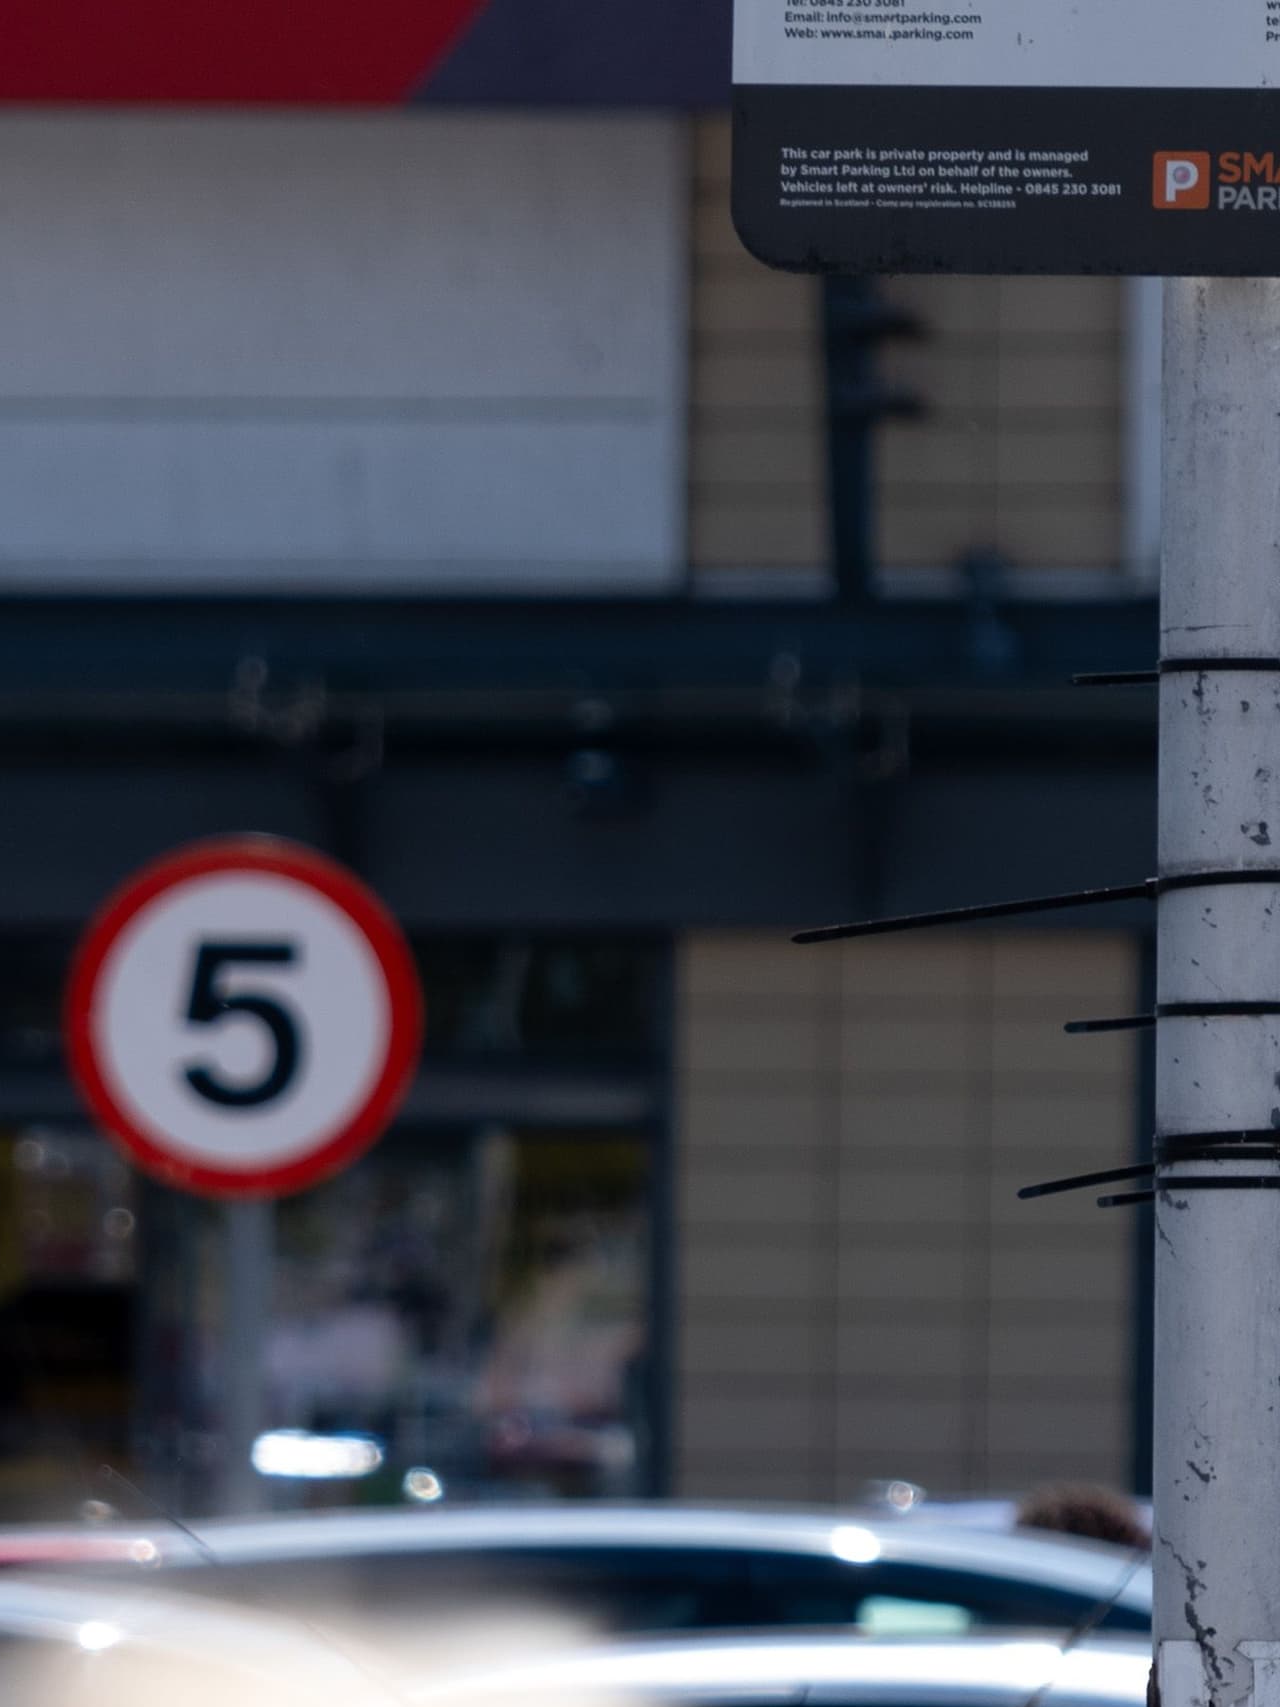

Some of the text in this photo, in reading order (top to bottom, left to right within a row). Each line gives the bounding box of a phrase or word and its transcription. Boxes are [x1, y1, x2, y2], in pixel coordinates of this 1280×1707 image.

[784, 11, 824, 23] Email:
[784, 27, 818, 39] Web:
[781, 147, 1089, 163] This car park is private property and is managed
[780, 164, 1073, 178] by Smart Parking Ltd on behalf of the owners.
[780, 180, 834, 193] Vehicles
[836, 181, 858, 193] left
[860, 182, 875, 193] at
[930, 182, 957, 194] risk.
[960, 182, 1014, 197] Helpline
[1024, 182, 1059, 195] 0845
[1062, 183, 1088, 196] 230
[1091, 183, 1121, 196] 3081
[1165, 160, 1199, 202] P
[1218, 186, 1280, 210] PAR
[182, 936, 304, 1110] 5
